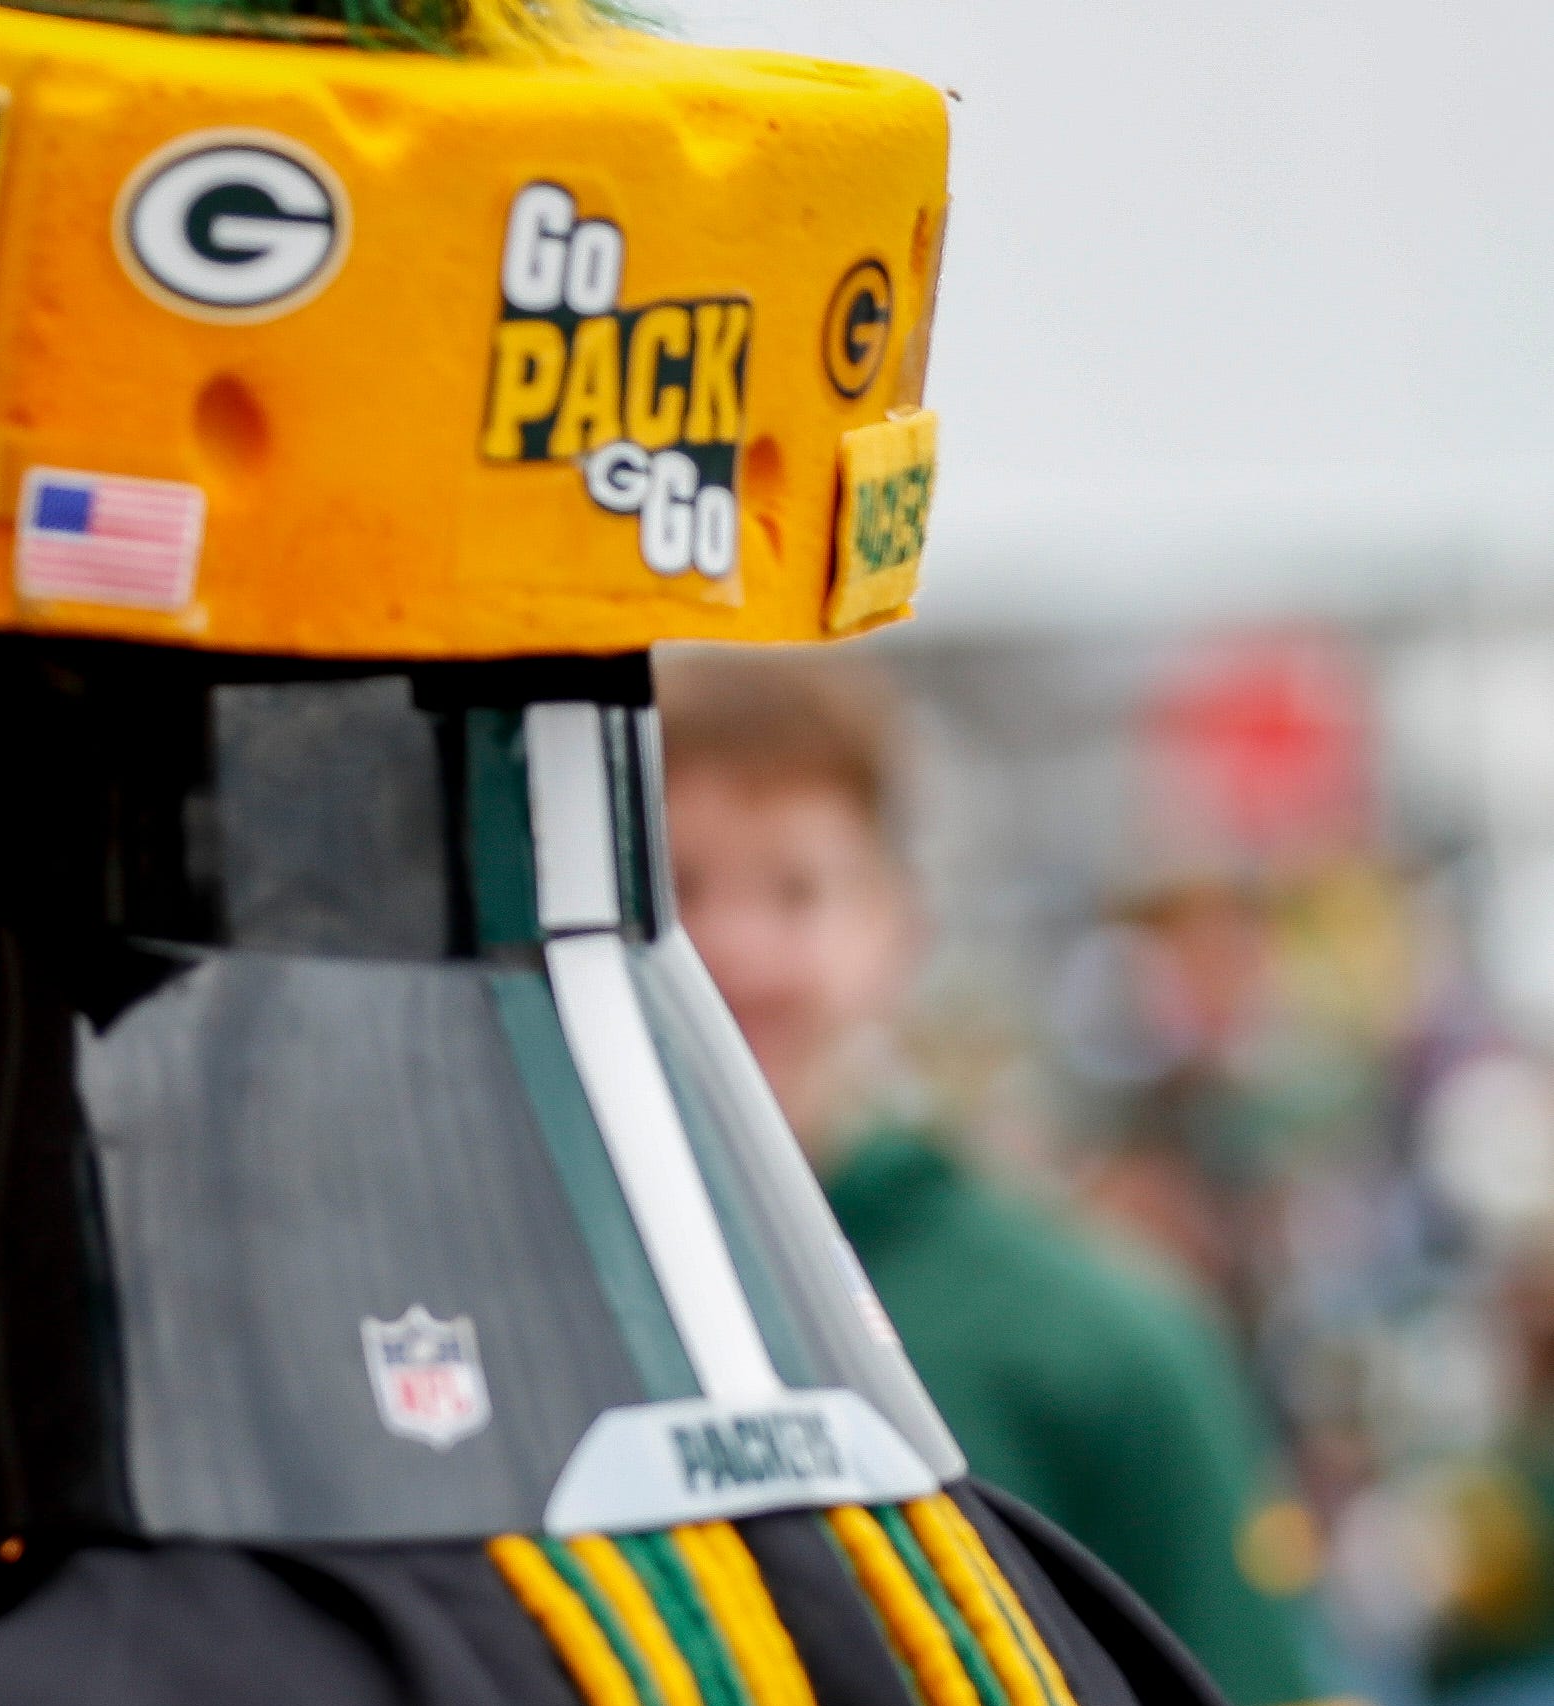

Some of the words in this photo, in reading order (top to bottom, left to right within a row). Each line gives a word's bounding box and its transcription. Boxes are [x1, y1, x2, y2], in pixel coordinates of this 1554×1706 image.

[128, 144, 335, 308] G
[482, 302, 751, 461] PACK
[821, 239, 896, 400] G
[582, 440, 652, 514] G
